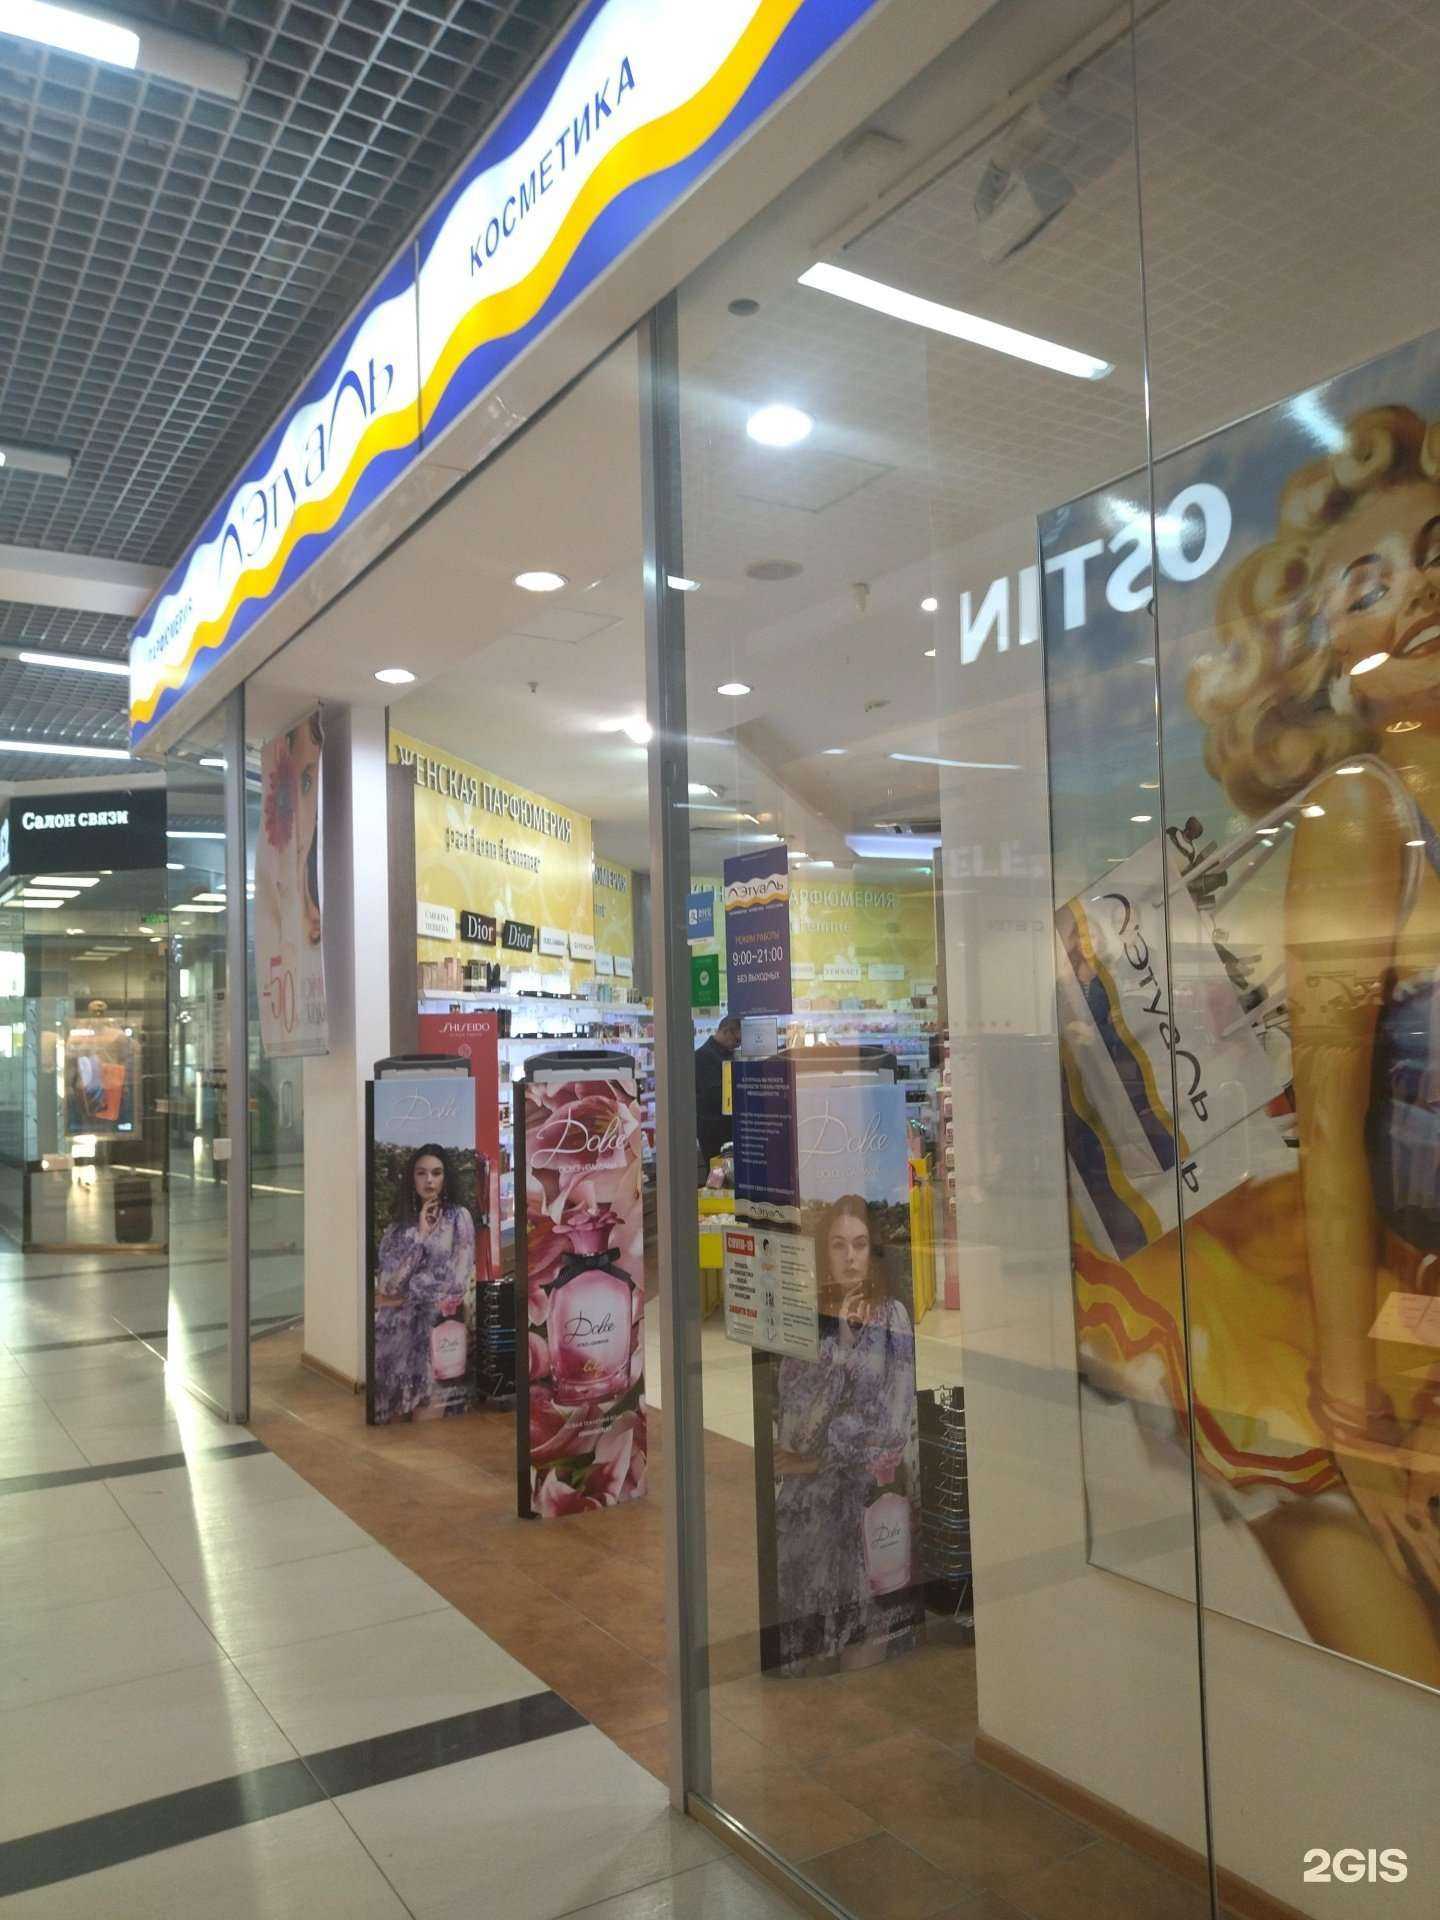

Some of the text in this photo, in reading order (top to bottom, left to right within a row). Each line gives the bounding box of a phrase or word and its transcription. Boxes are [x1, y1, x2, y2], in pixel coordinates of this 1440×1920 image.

[470, 55, 636, 278] КОСМЕТИКА
[397, 744, 572, 843] ЖЕНСКАЯ ПАРФЮМЕРИЯ
[788, 888, 897, 911] АРФЮМЕРИЯ
[467, 914, 495, 943] Dior
[508, 925, 532, 949] Dior
[439, 1022, 490, 1033] SHISEIDO
[531, 1107, 630, 1169] Dolce
[564, 1311, 615, 1345] Dolce
